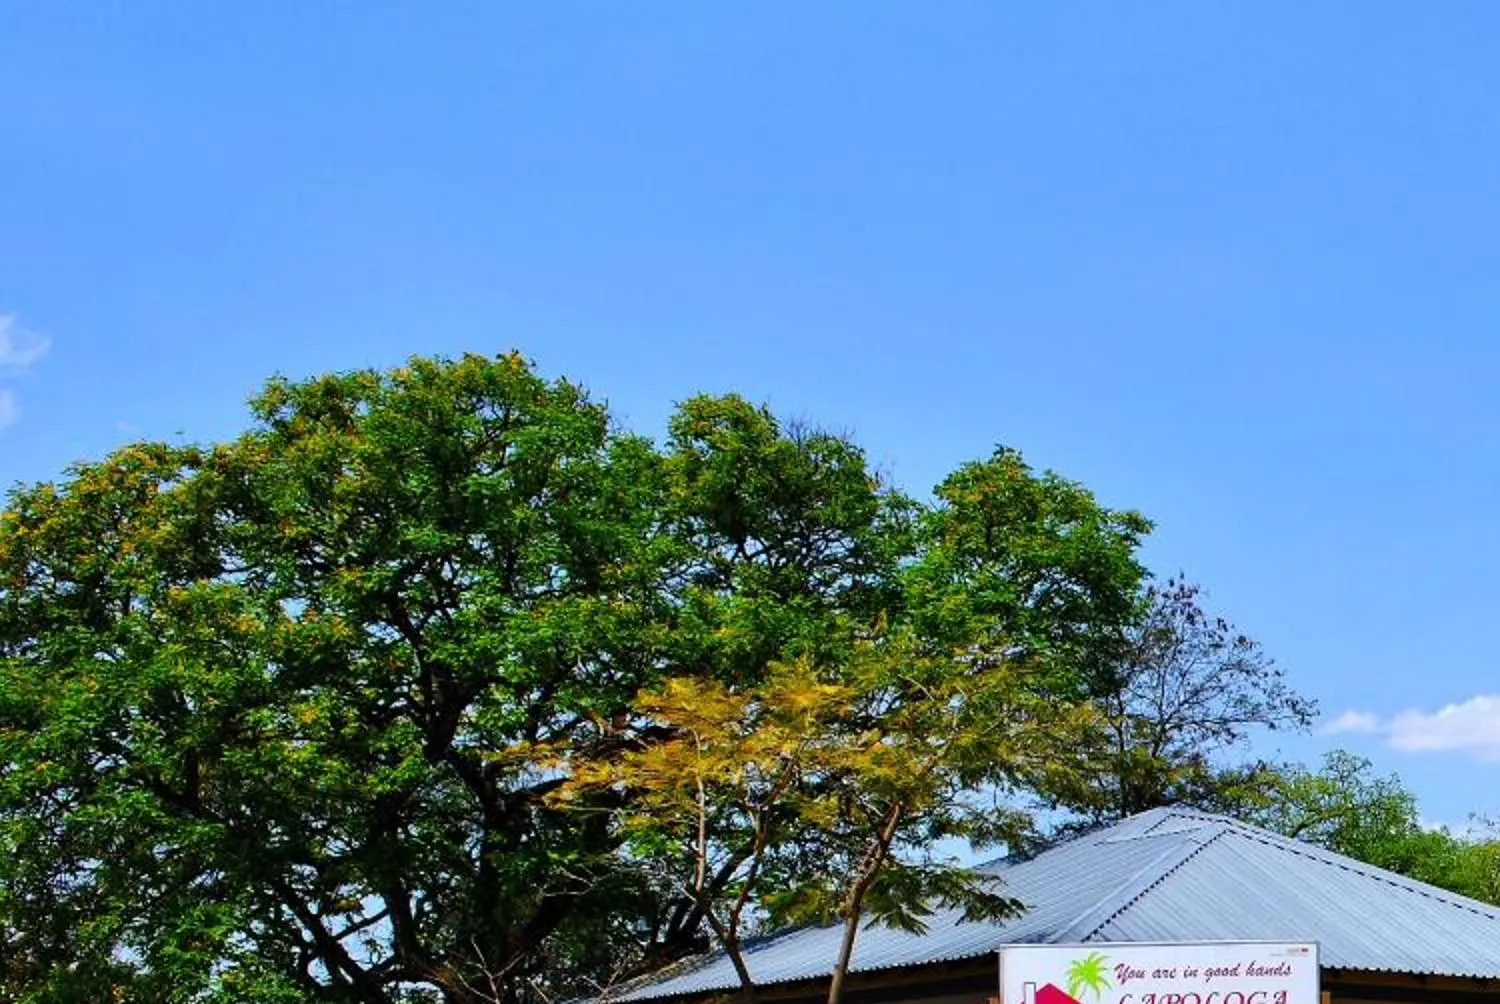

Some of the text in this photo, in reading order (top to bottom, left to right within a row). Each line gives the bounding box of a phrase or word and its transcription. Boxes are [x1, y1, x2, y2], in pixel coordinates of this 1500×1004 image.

[1114, 959, 1293, 985] You are in good hands
